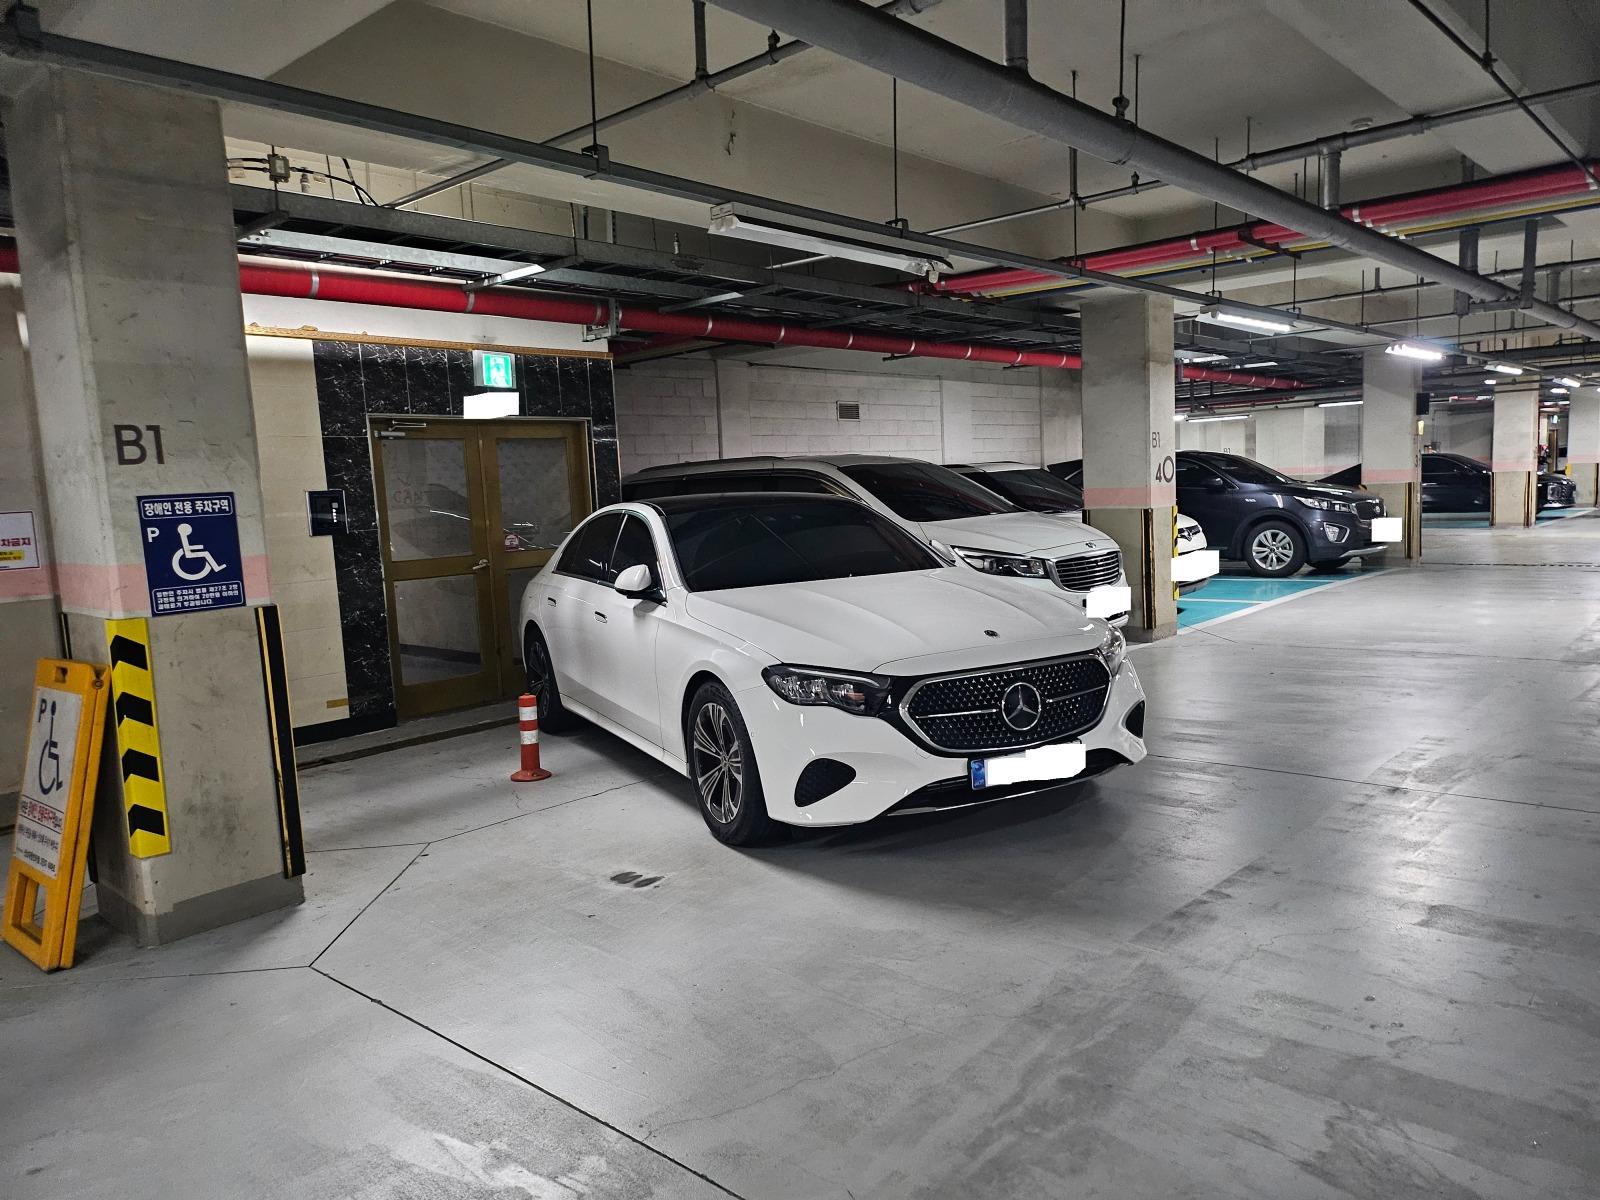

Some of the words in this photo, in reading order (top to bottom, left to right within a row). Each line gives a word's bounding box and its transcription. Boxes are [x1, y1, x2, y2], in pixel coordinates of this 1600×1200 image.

[114, 424, 165, 466] B1
[1152, 431, 1161, 448] B1
[1155, 455, 1174, 483] 40
[144, 502, 172, 516] 장애인
[174, 501, 192, 514] 전용
[194, 499, 229, 513] 주차구역
[146, 527, 160, 543] P
[38, 698, 47, 723] P
